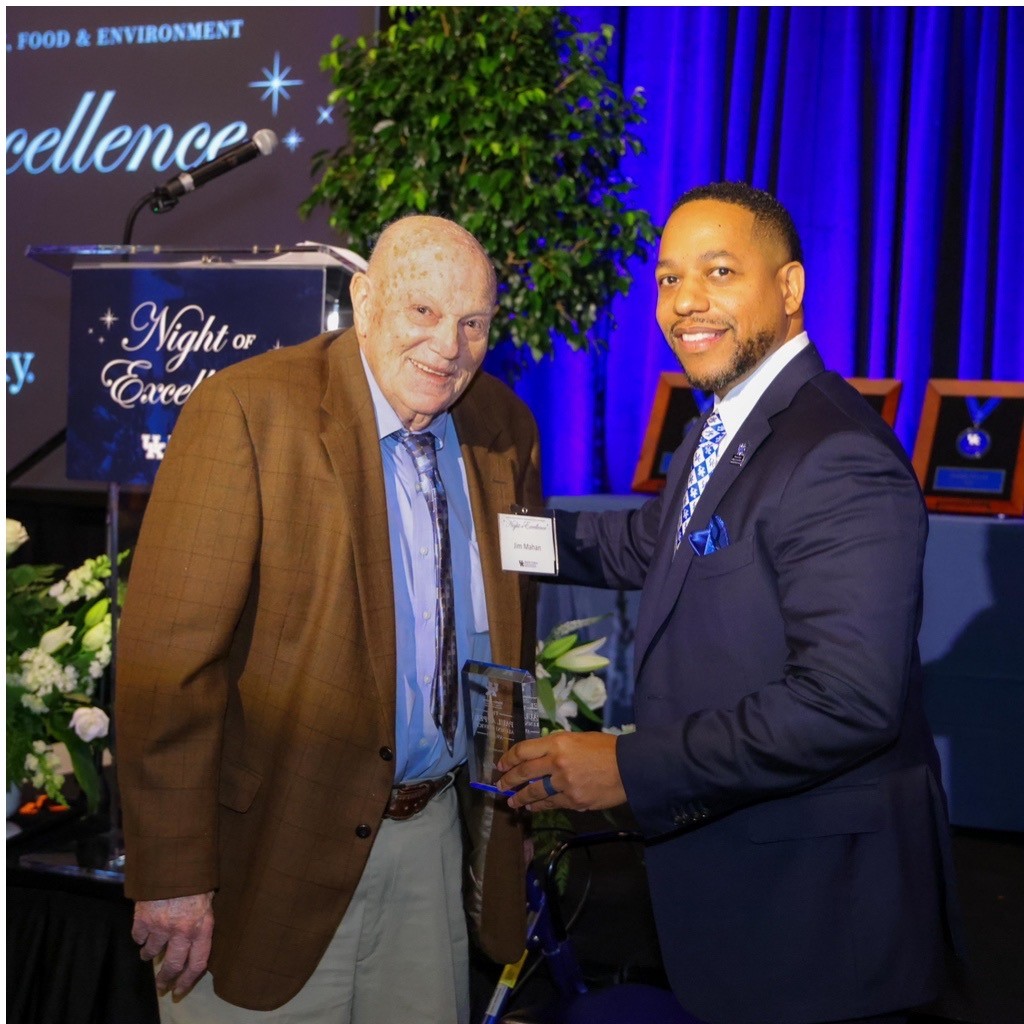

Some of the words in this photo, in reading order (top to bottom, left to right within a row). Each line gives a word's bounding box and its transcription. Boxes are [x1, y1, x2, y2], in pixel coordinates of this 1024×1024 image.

[17, 29, 70, 51] FOOD
[76, 28, 91, 48] &
[97, 19, 245, 47] ENVIRONMENT
[121, 301, 229, 373] Night
[232, 333, 257, 350] OF
